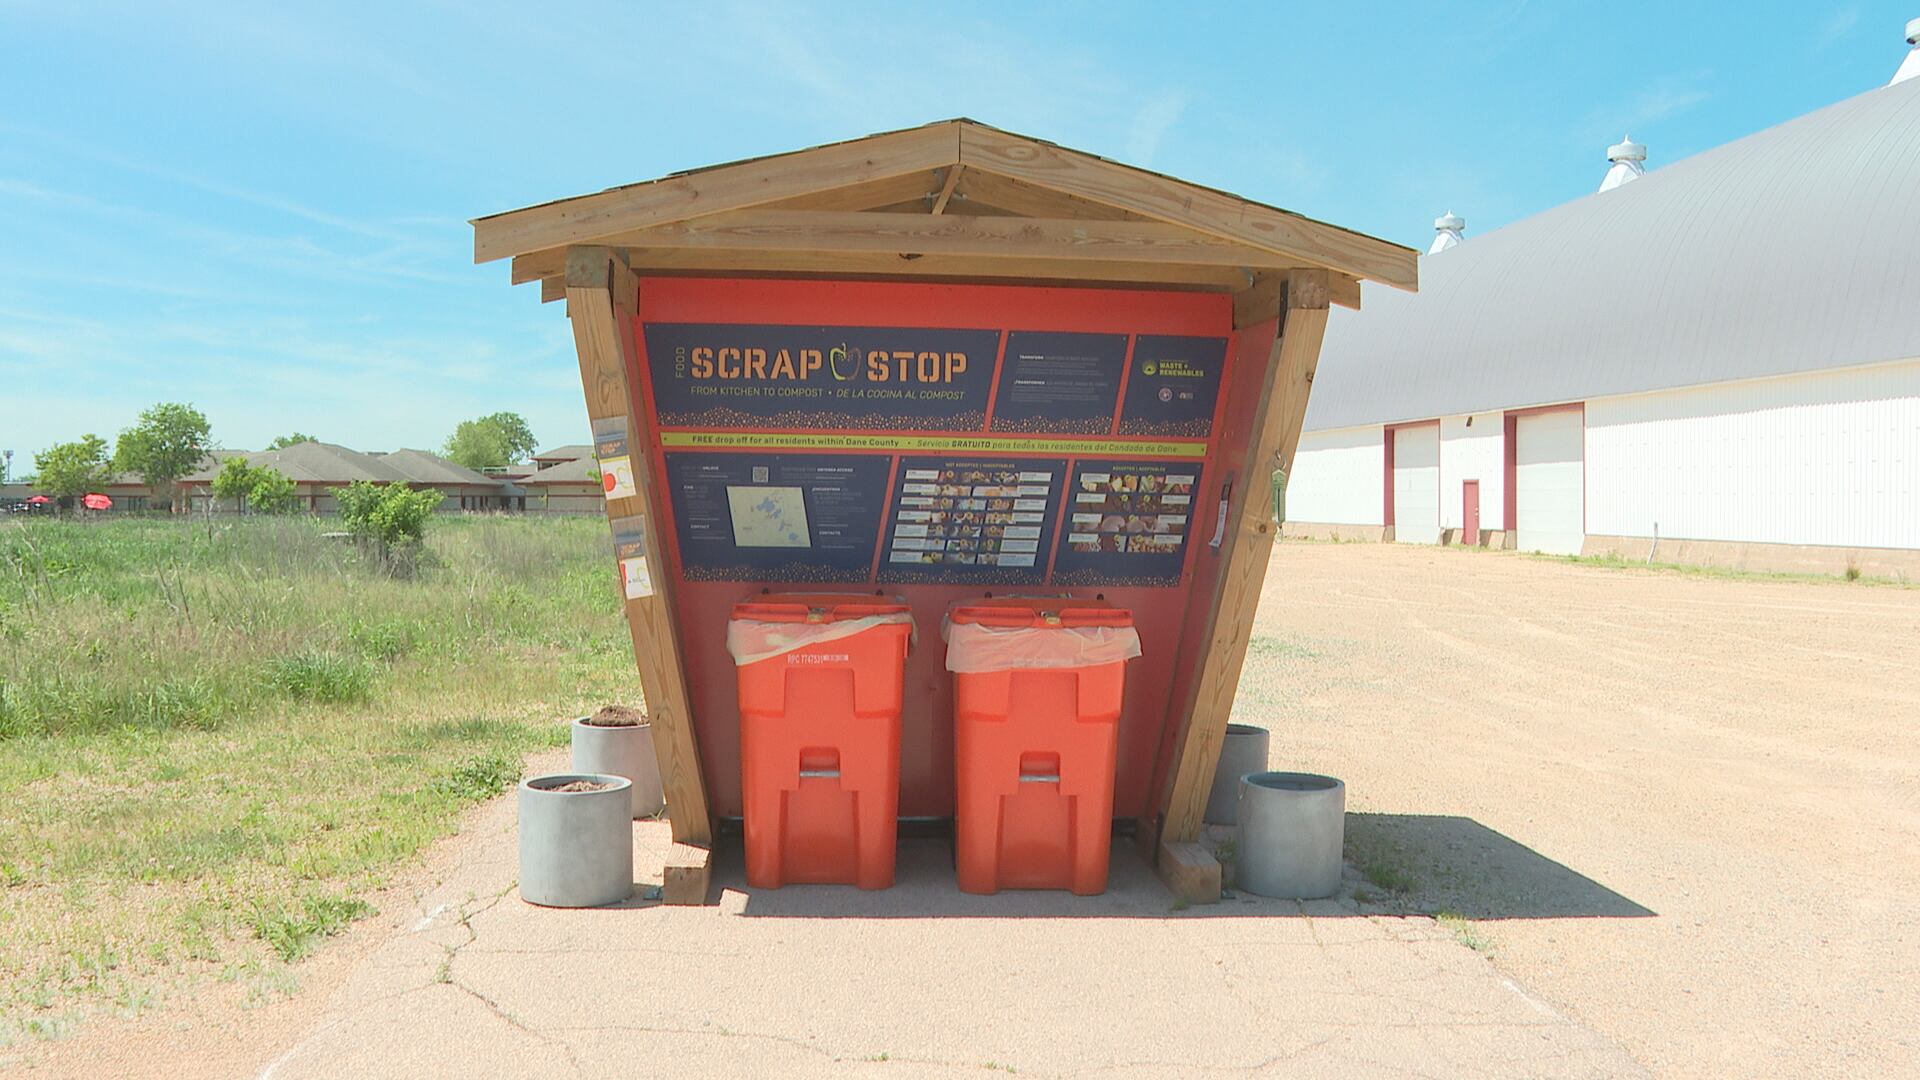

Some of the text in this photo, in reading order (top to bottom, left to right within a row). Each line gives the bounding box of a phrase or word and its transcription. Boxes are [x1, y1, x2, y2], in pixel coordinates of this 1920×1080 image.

[675, 346, 686, 379] FOOD
[691, 347, 968, 383] SCRAP STOP
[690, 386, 966, 401] FROM KITCHEN TO COMPOST DE LA COCINA AL COMPOST
[715, 436, 735, 446] drop
[749, 436, 762, 444] for
[764, 436, 774, 444] all
[776, 437, 816, 445] residents
[818, 437, 843, 445] within
[846, 438, 867, 446] Dane
[869, 439, 899, 448] County
[951, 440, 991, 448] GRATUITO
